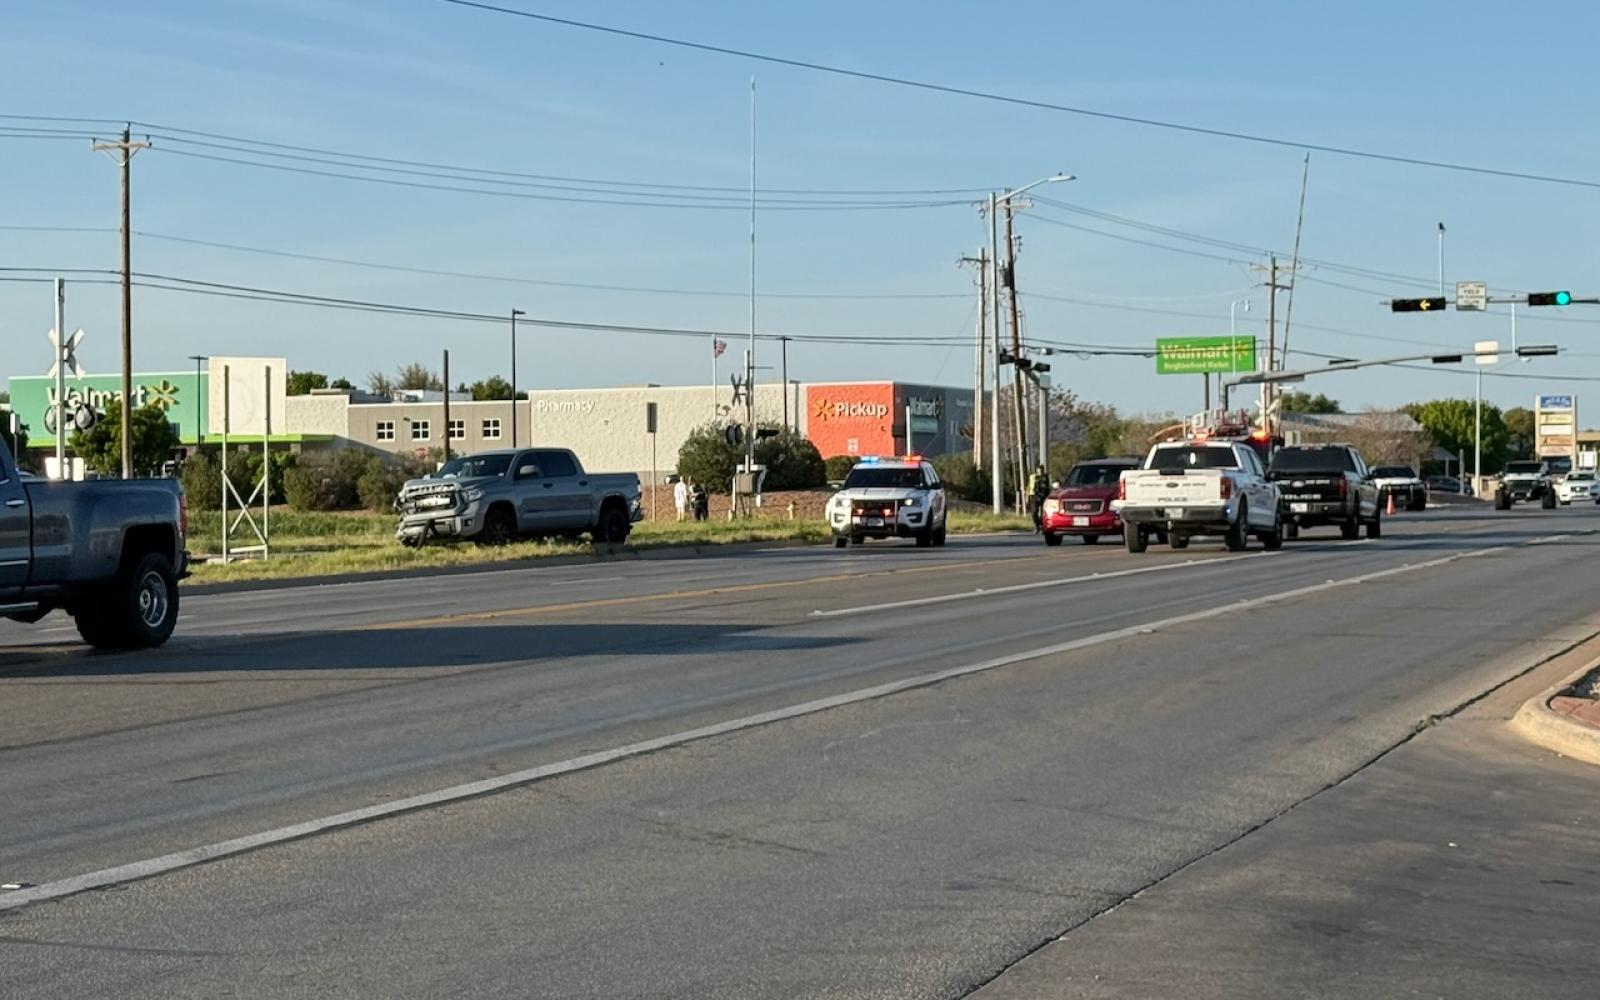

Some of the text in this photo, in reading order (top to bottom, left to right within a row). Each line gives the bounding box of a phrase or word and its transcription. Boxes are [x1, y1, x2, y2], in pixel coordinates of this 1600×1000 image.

[1161, 343, 1229, 359] Walmart
[1164, 360, 1229, 370] Neighborhood Market
[538, 400, 595, 414] Pharmacy
[835, 402, 887, 418] Pickup
